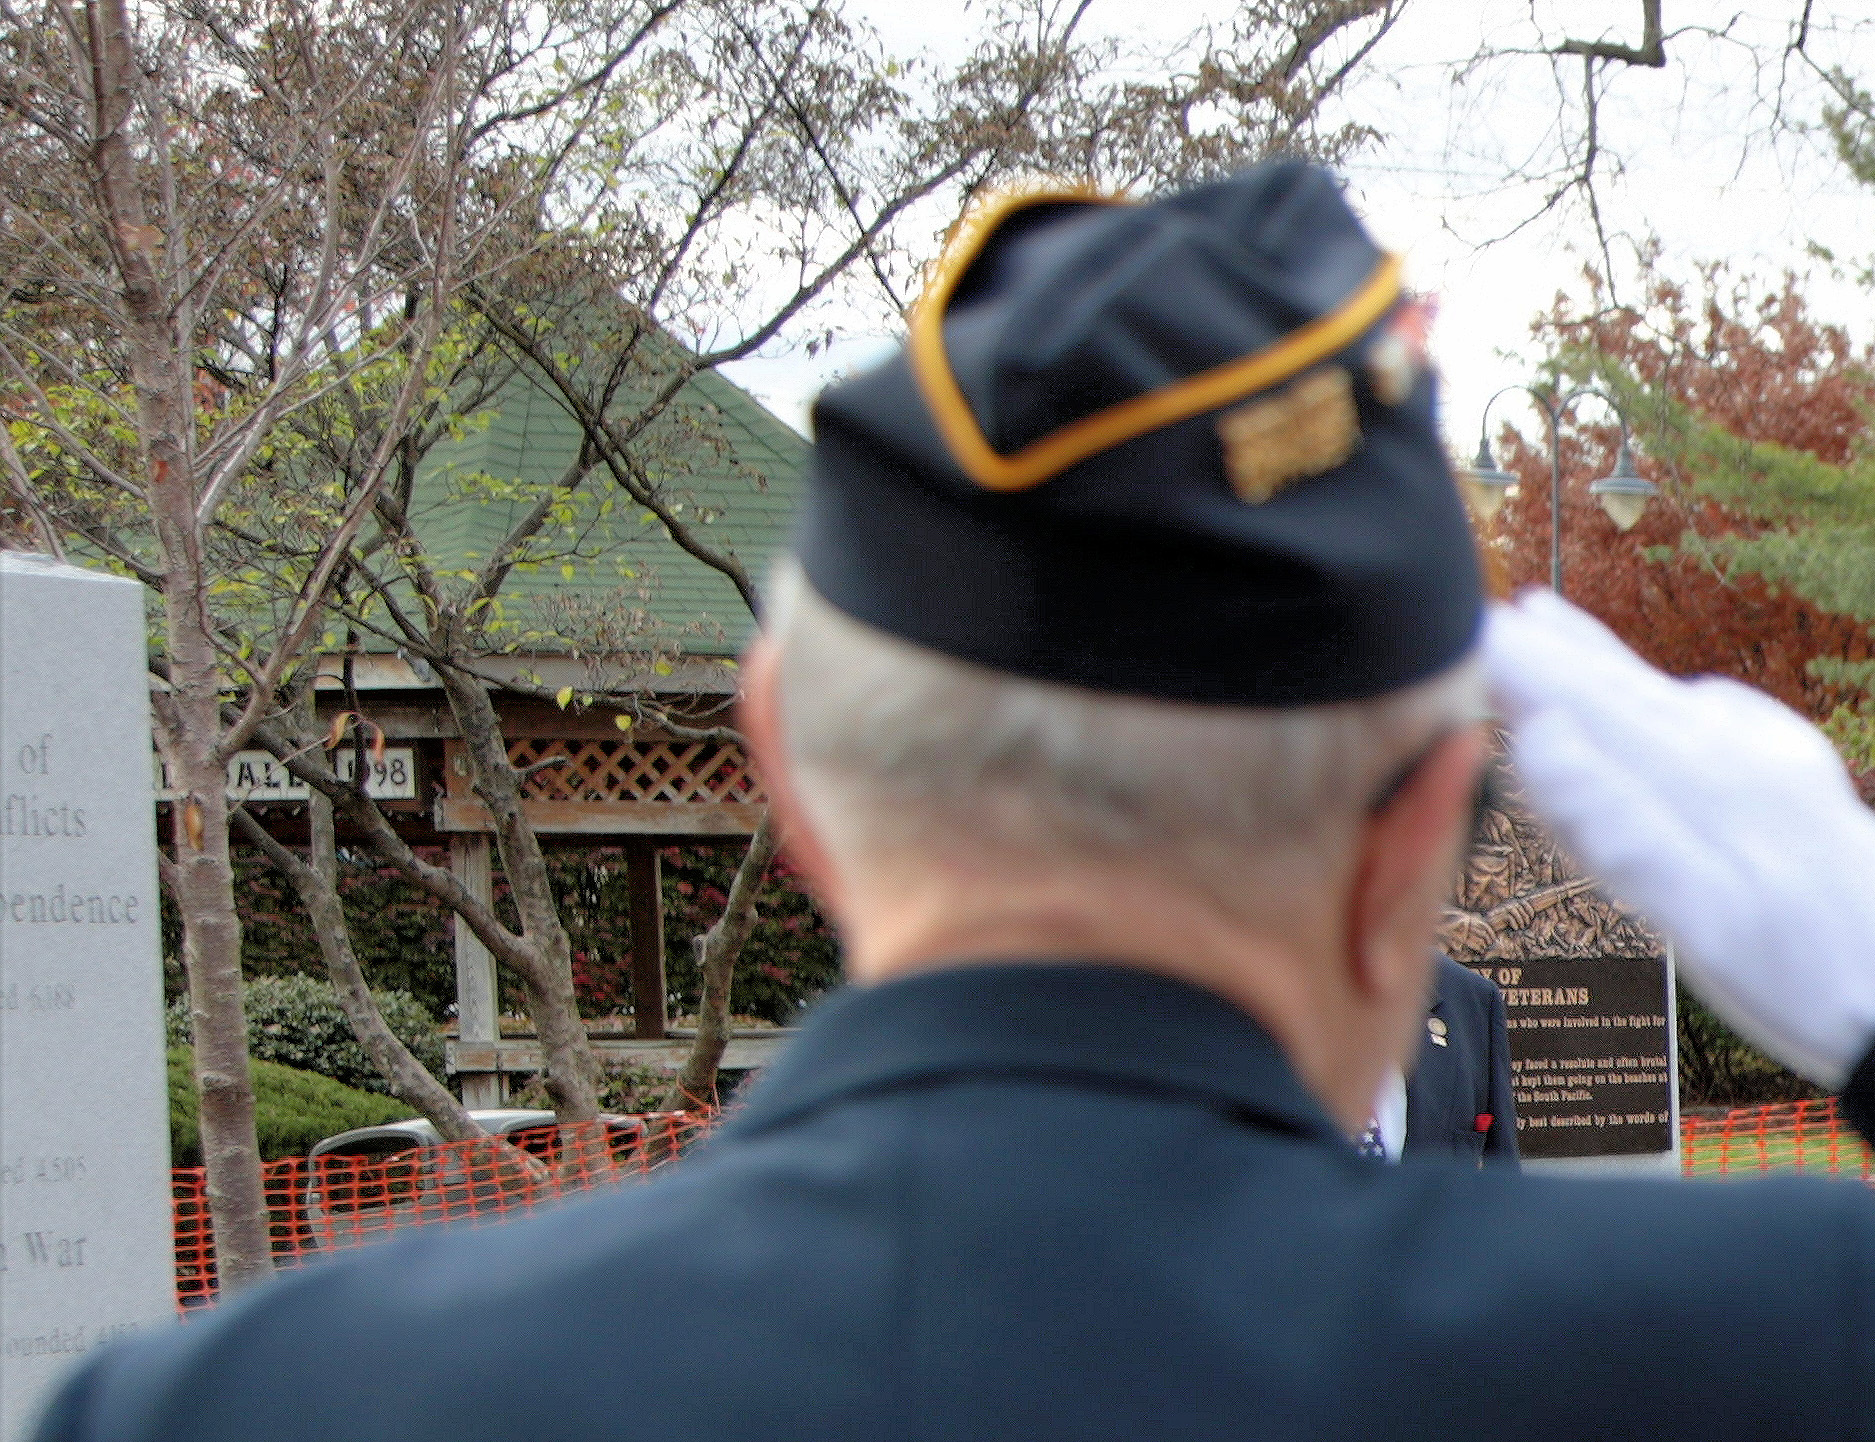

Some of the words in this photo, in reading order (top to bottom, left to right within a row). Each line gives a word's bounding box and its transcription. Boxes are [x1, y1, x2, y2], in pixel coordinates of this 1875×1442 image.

[19, 732, 54, 774] of
[1498, 967, 1523, 985] OF
[1519, 1017, 1538, 1028] who
[1540, 1018, 1562, 1028] were
[1563, 1016, 1599, 1028] involved
[1601, 1015, 1611, 1027] in
[1613, 1015, 1627, 1027] the
[1629, 1015, 1651, 1029] fight
[1652, 1014, 1666, 1027] for
[1524, 1059, 1549, 1070] faced
[1597, 1057, 1614, 1068] and
[1616, 1056, 1639, 1067] often
[1641, 1055, 1667, 1067] brutal
[1521, 1074, 1541, 1088] kept
[1543, 1074, 1566, 1086] them
[1567, 1073, 1593, 1087] going
[1594, 1074, 1606, 1085] on
[1608, 1073, 1623, 1084] the
[1517, 1090, 1532, 1102] the
[1533, 1090, 1559, 1102] South
[1529, 1116, 1548, 1127] best
[1550, 1114, 1592, 1127] described
[1594, 1113, 1606, 1128] by
[1609, 1113, 1623, 1125] the
[1626, 1111, 1655, 1124] words
[1657, 1110, 1669, 1123] of
[23, 1231, 87, 1268] War
[5, 1322, 88, 1358] ounded
